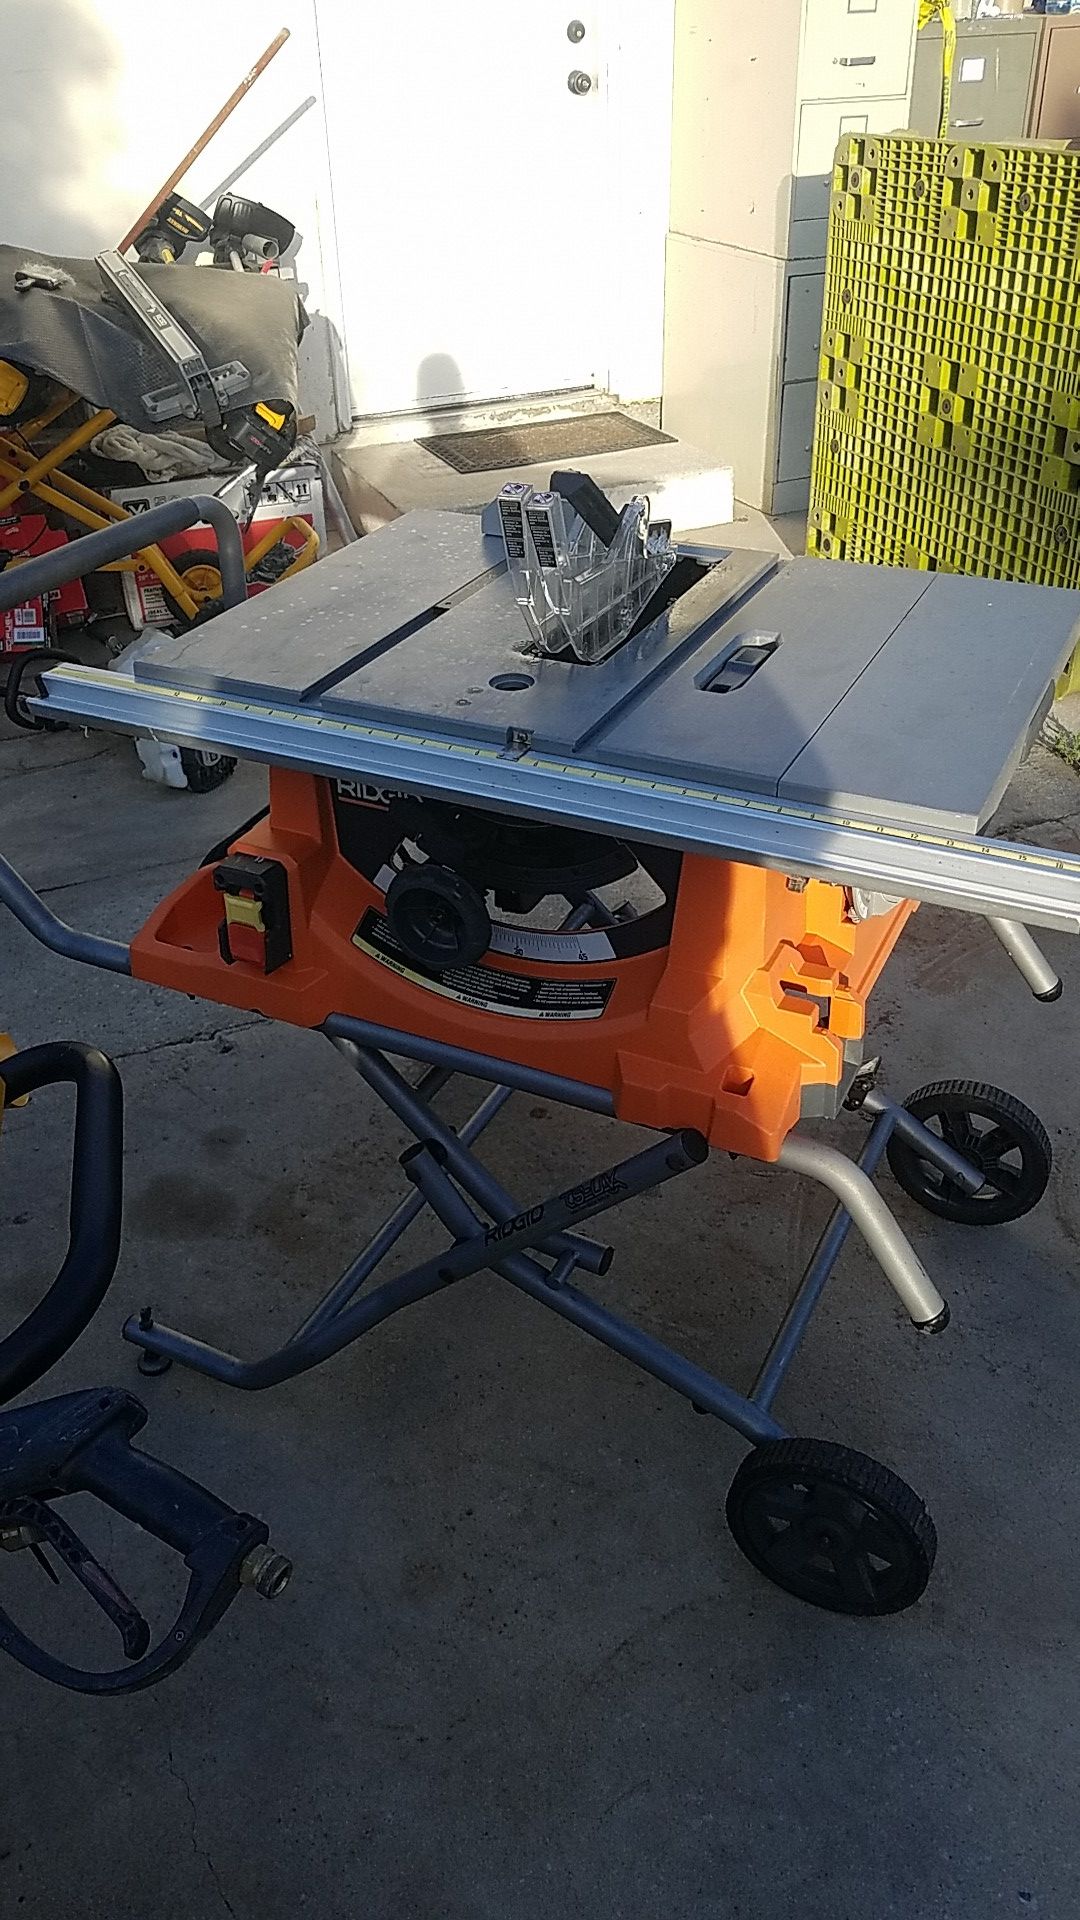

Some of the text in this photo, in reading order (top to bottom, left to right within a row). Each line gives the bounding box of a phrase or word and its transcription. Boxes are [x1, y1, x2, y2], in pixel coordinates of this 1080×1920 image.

[513, 946, 524, 956] 30
[578, 952, 588, 961] 45
[380, 955, 406, 974] WARNING
[462, 995, 489, 1009] WARNING
[544, 1011, 572, 1019] WARNING
[484, 1204, 545, 1247] RIDGID
